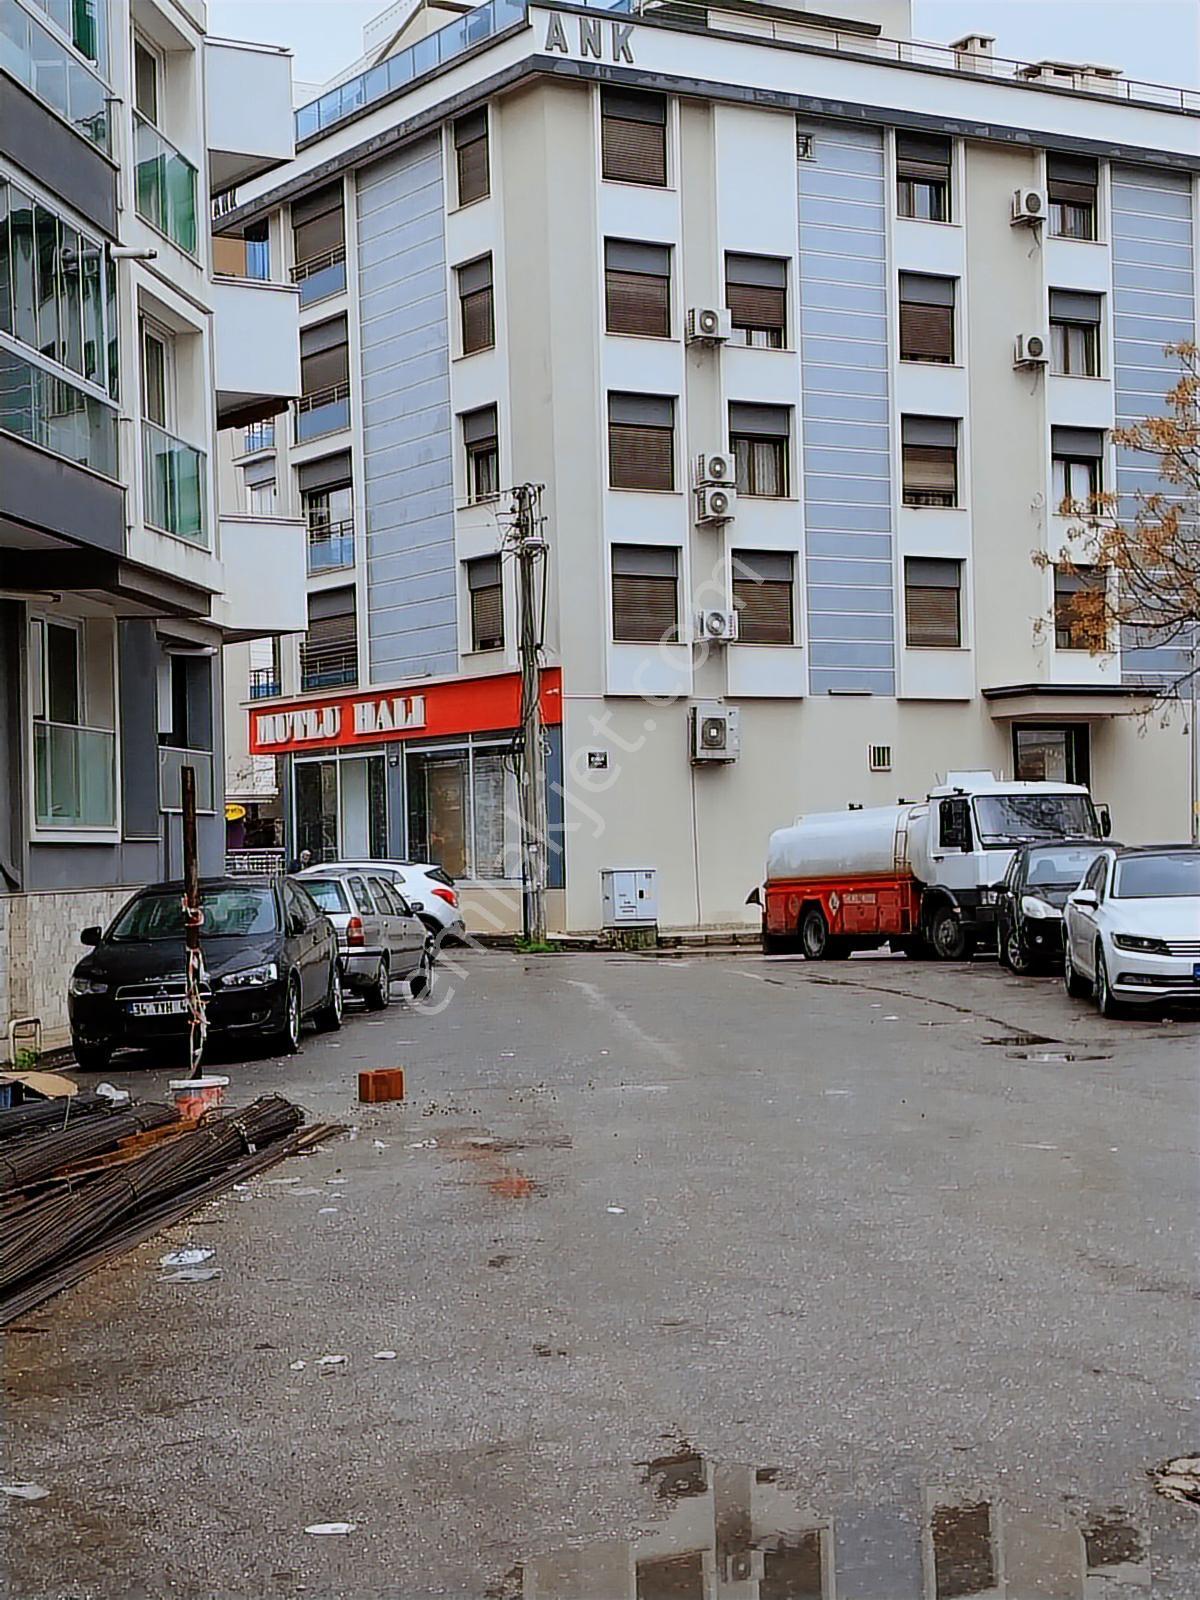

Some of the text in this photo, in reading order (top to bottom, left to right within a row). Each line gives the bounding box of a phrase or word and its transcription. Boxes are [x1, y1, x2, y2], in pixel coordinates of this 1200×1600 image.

[544, 12, 634, 63] ANK
[256, 695, 427, 746] MUTLU HALI
